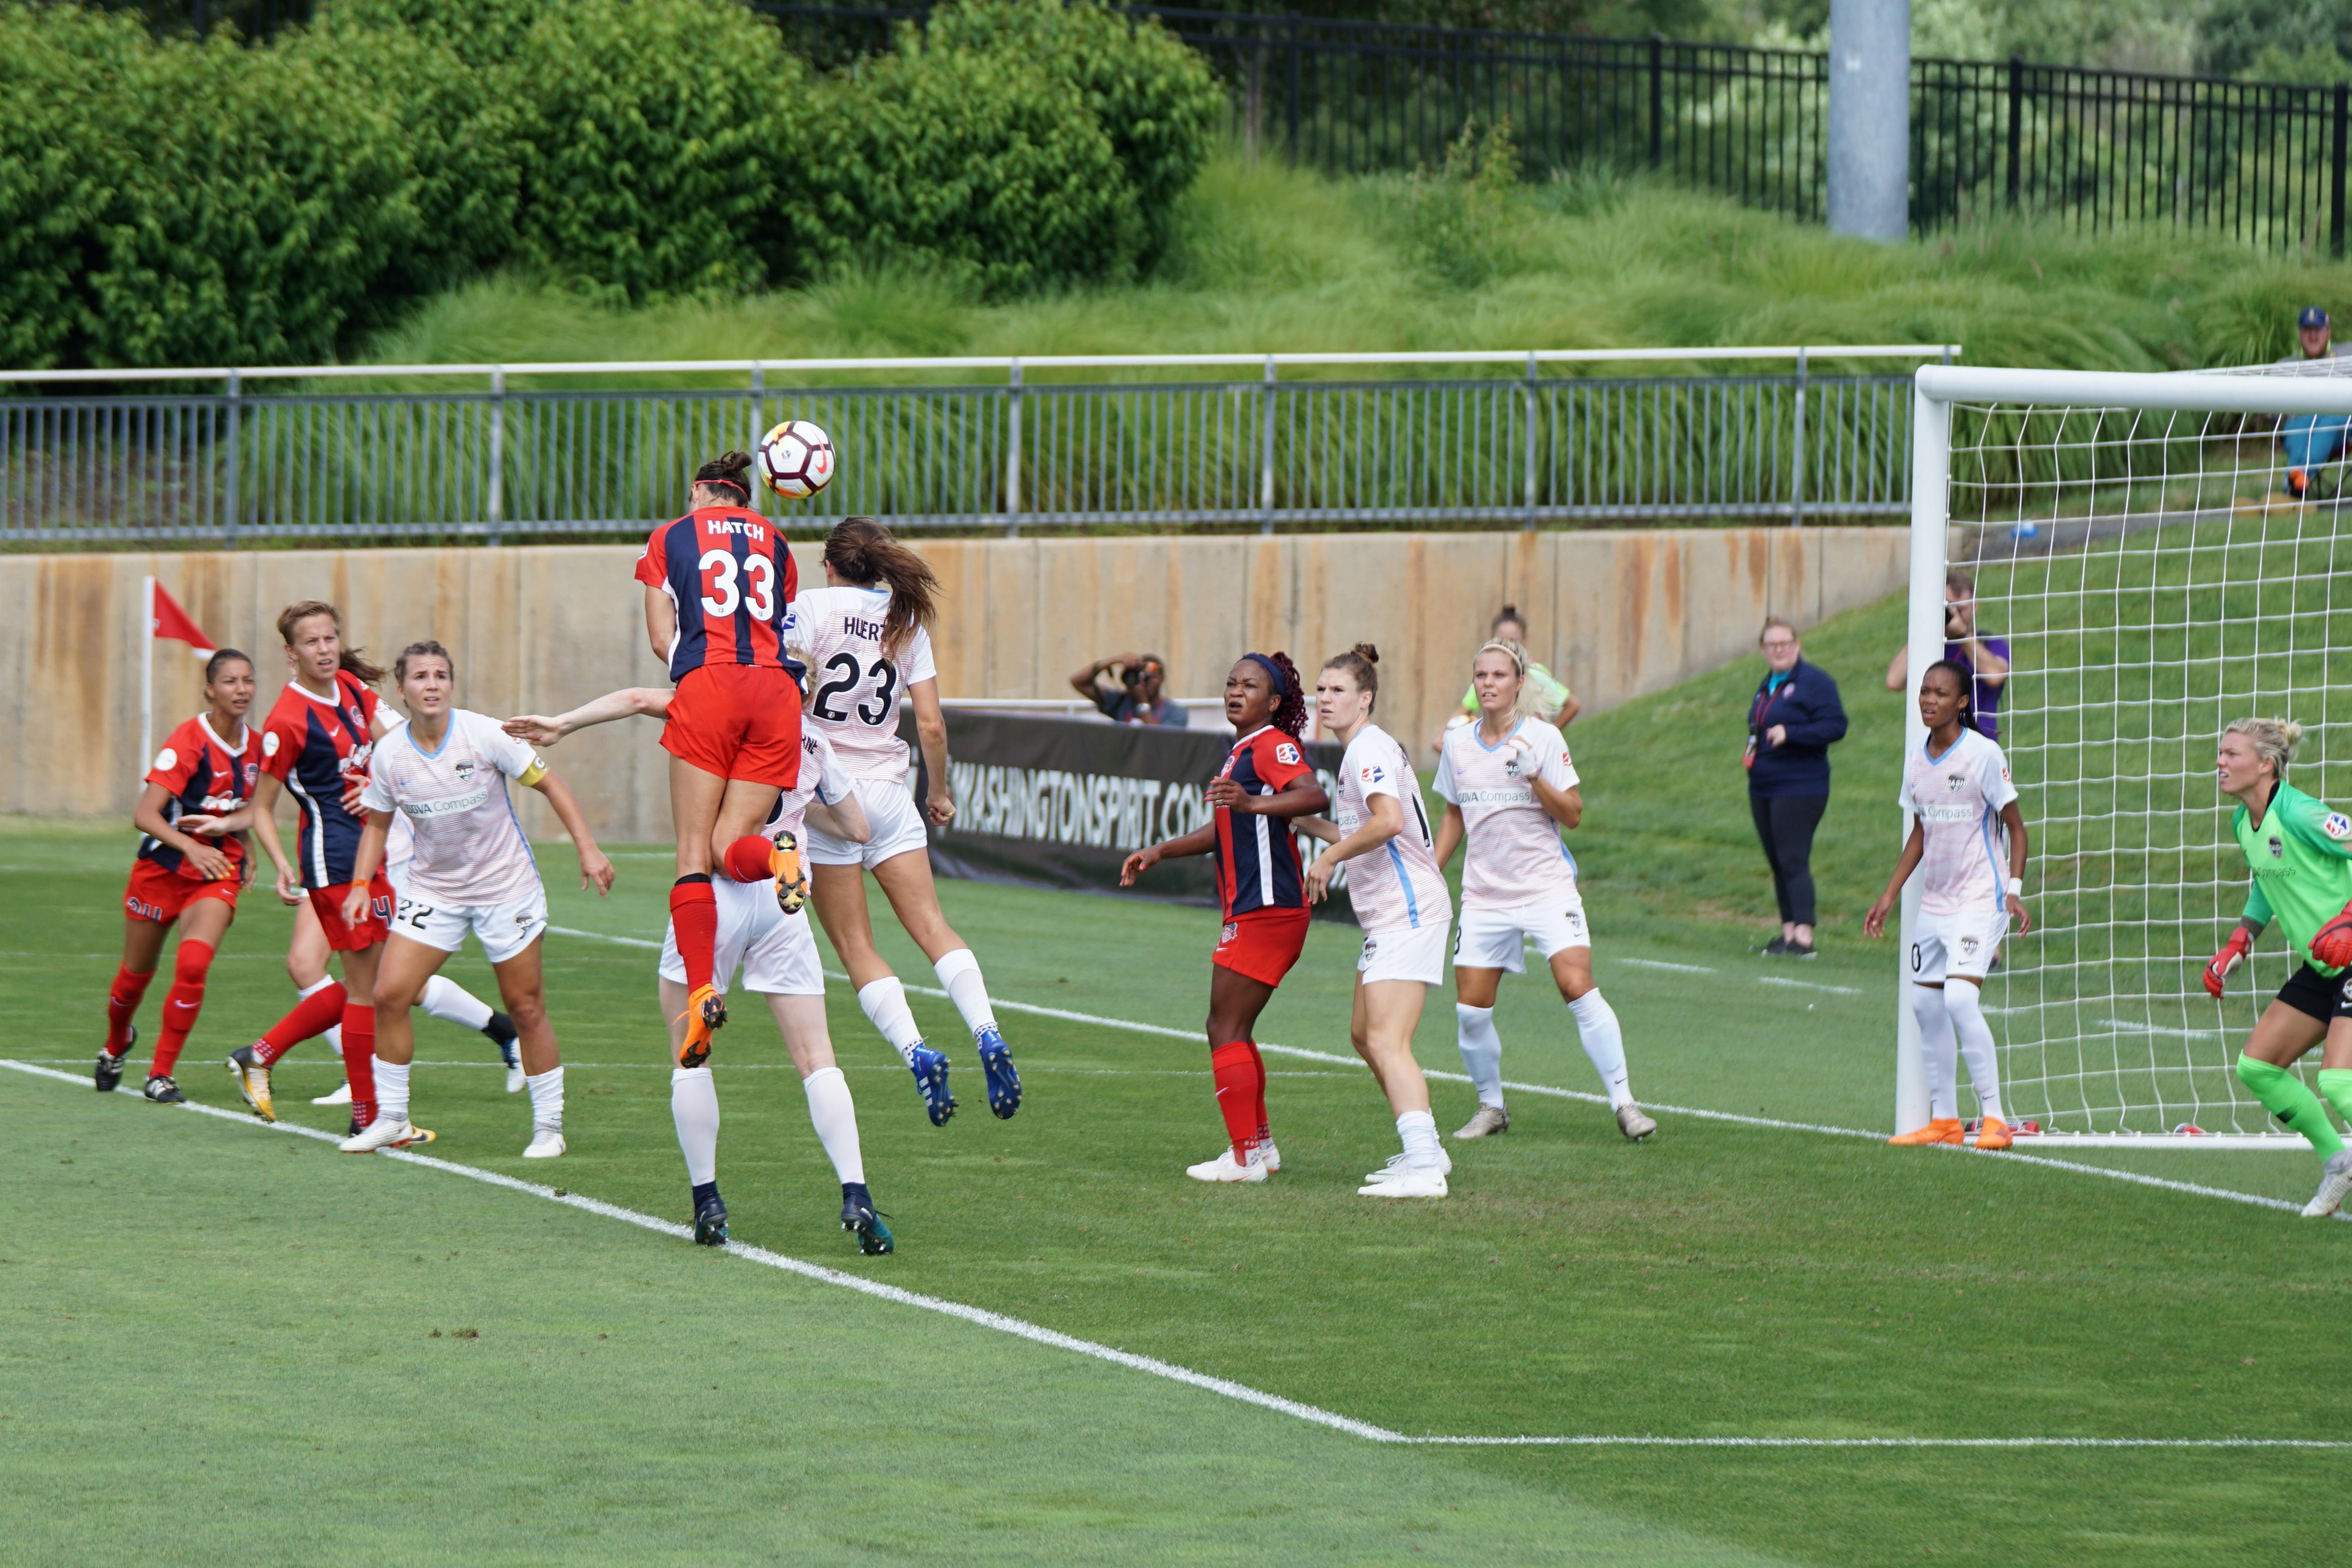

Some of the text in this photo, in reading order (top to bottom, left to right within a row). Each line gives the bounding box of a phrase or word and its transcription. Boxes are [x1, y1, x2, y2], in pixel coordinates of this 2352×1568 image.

[707, 520, 764, 542] HATCH
[698, 548, 775, 621] 33
[844, 616, 885, 641] HUER
[812, 652, 897, 725] 23
[434, 791, 488, 812] Compass
[1480, 790, 1530, 803] Compass
[372, 895, 394, 930] 4
[397, 899, 434, 930] 22
